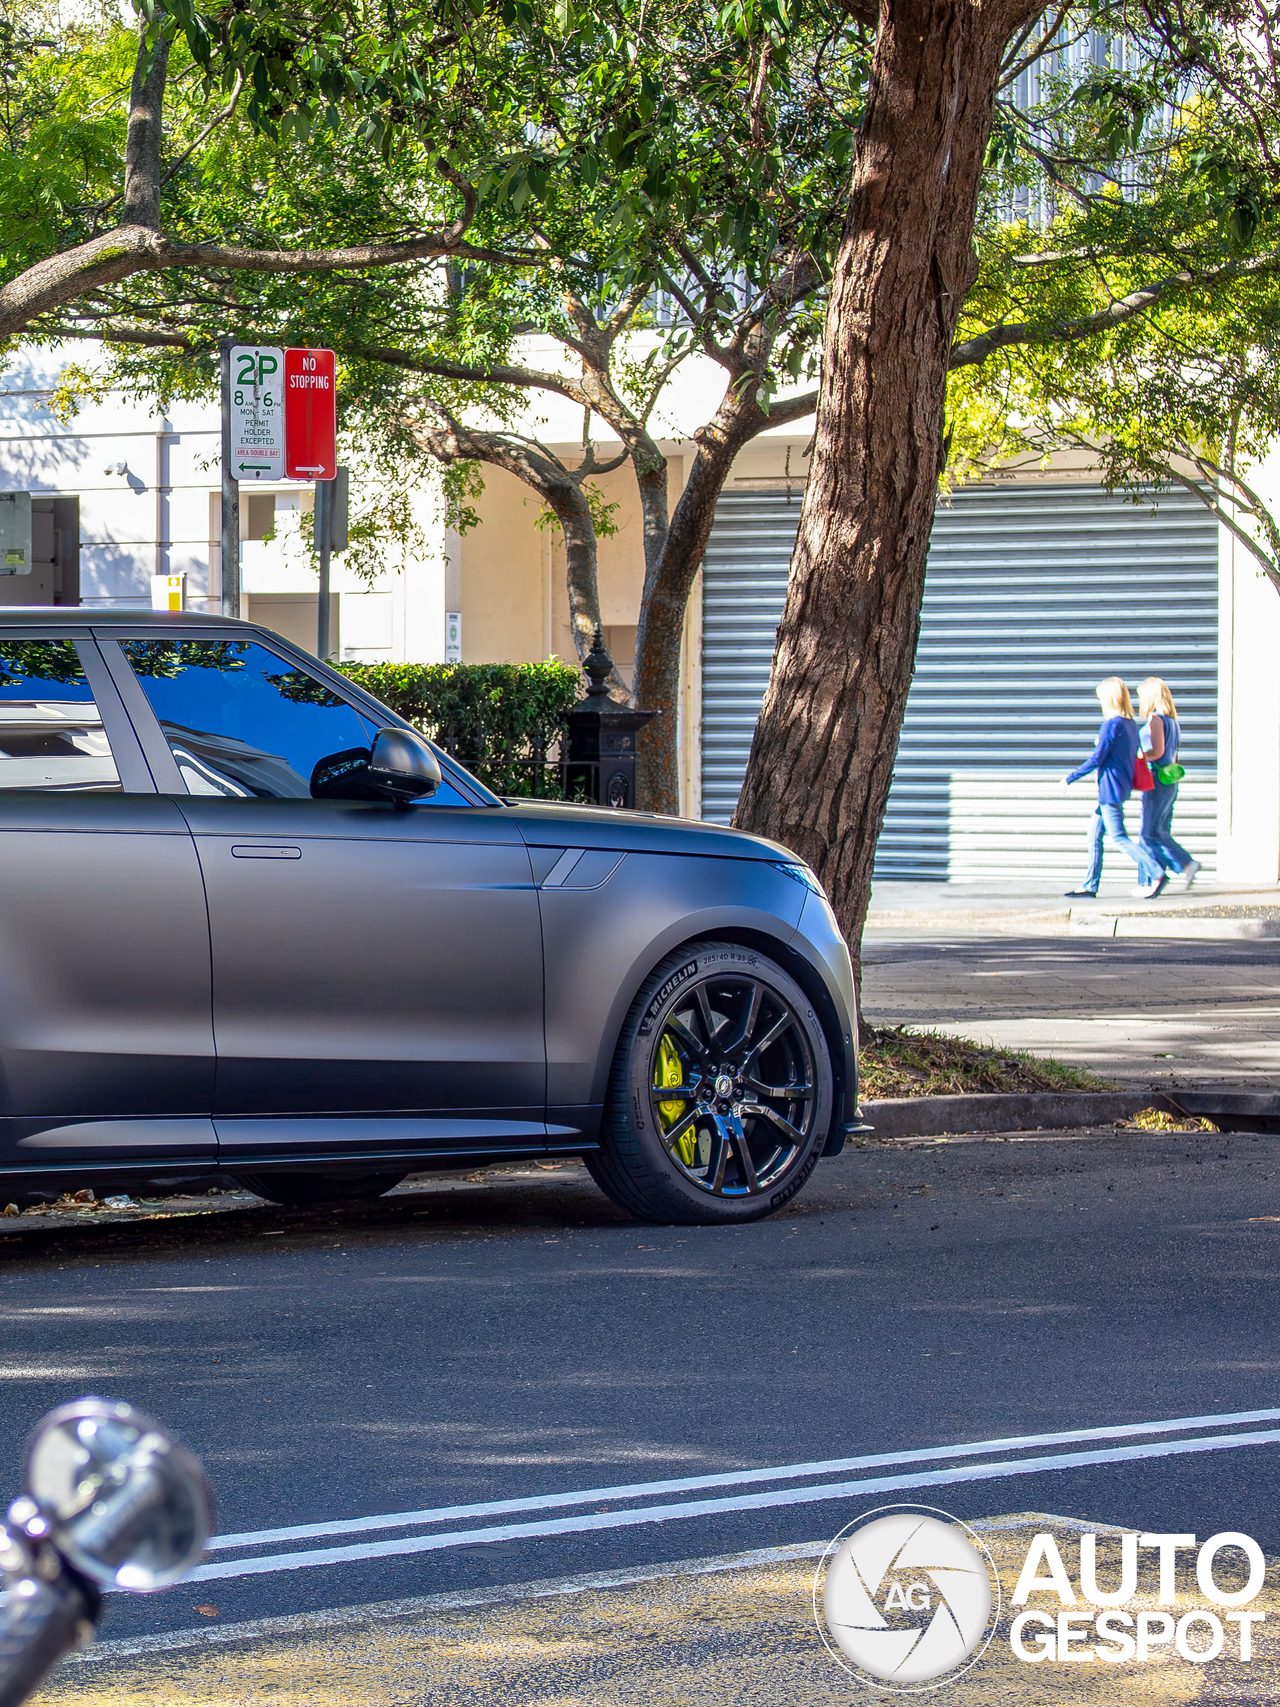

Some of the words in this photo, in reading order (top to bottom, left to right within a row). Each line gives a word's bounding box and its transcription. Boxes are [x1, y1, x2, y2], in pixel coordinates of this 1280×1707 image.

[236, 354, 278, 385] 2P
[302, 357, 317, 371] NO
[290, 374, 329, 389] STOPPING
[240, 437, 275, 445] EXCEPTED
[703, 953, 729, 965] 285/40
[650, 962, 696, 1017] MICHELIN
